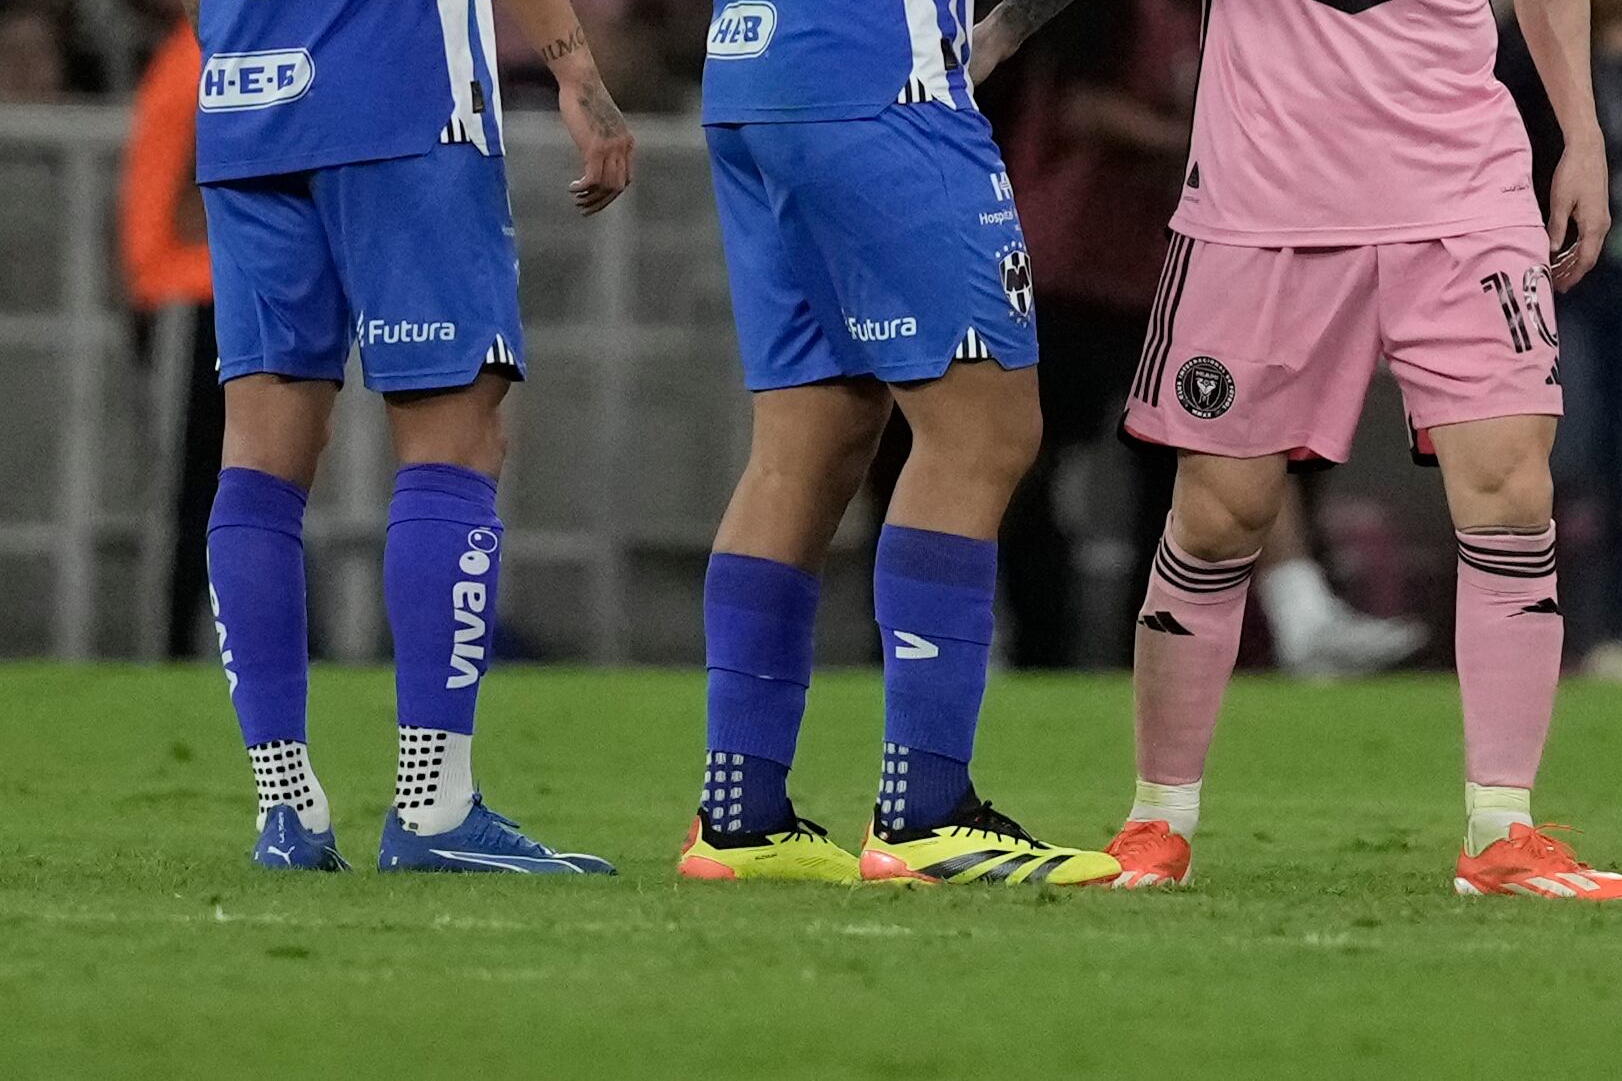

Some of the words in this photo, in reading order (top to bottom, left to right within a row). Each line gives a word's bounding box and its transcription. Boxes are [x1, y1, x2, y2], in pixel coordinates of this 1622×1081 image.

[369, 320, 455, 345] Futura
[849, 317, 918, 342] Futura
[1480, 264, 1558, 354] 10
[445, 581, 487, 689] viva
